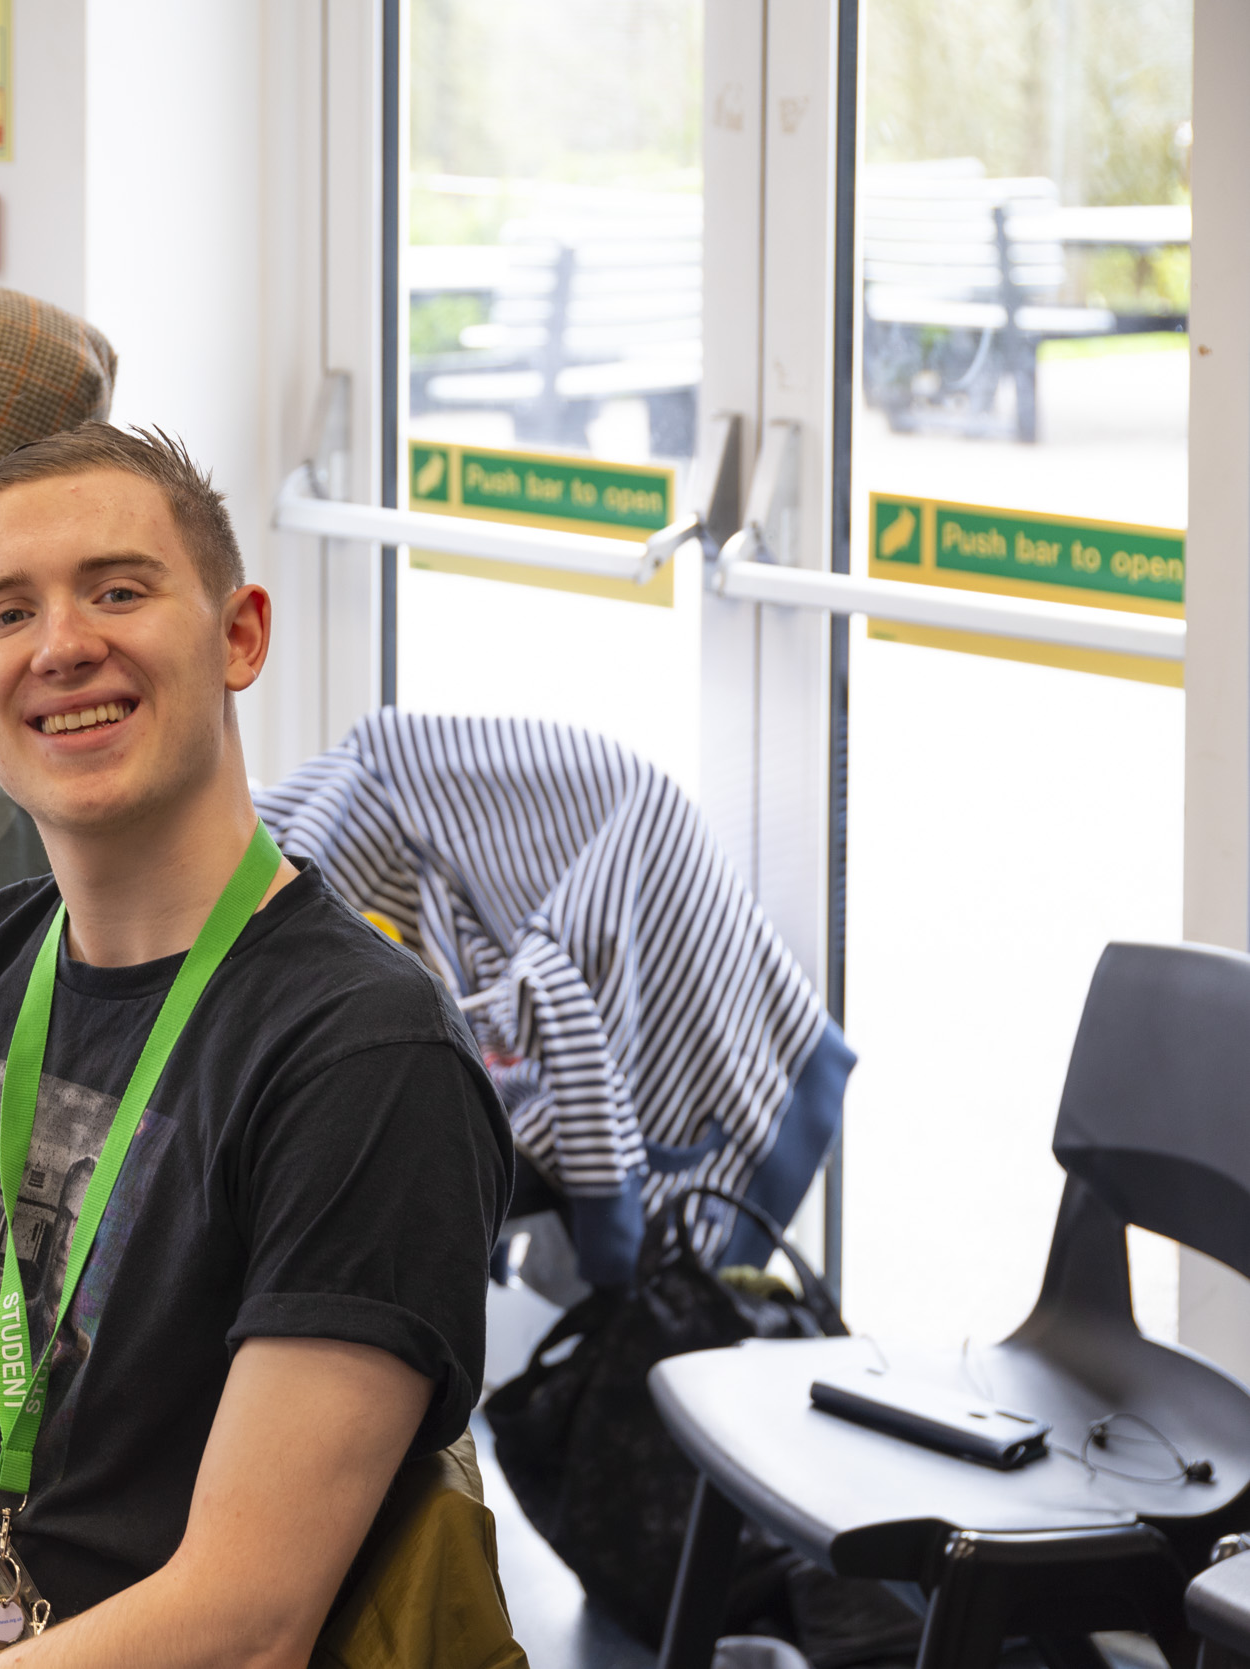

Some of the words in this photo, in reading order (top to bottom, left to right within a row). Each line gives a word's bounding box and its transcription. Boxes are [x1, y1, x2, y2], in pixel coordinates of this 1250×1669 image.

[465, 462, 521, 497] Push
[525, 470, 564, 503] bar
[570, 476, 598, 508] to
[602, 485, 663, 515] open
[941, 520, 1007, 556] Push
[1015, 531, 1061, 568] bar
[1071, 539, 1102, 574] to
[1110, 550, 1184, 585] open
